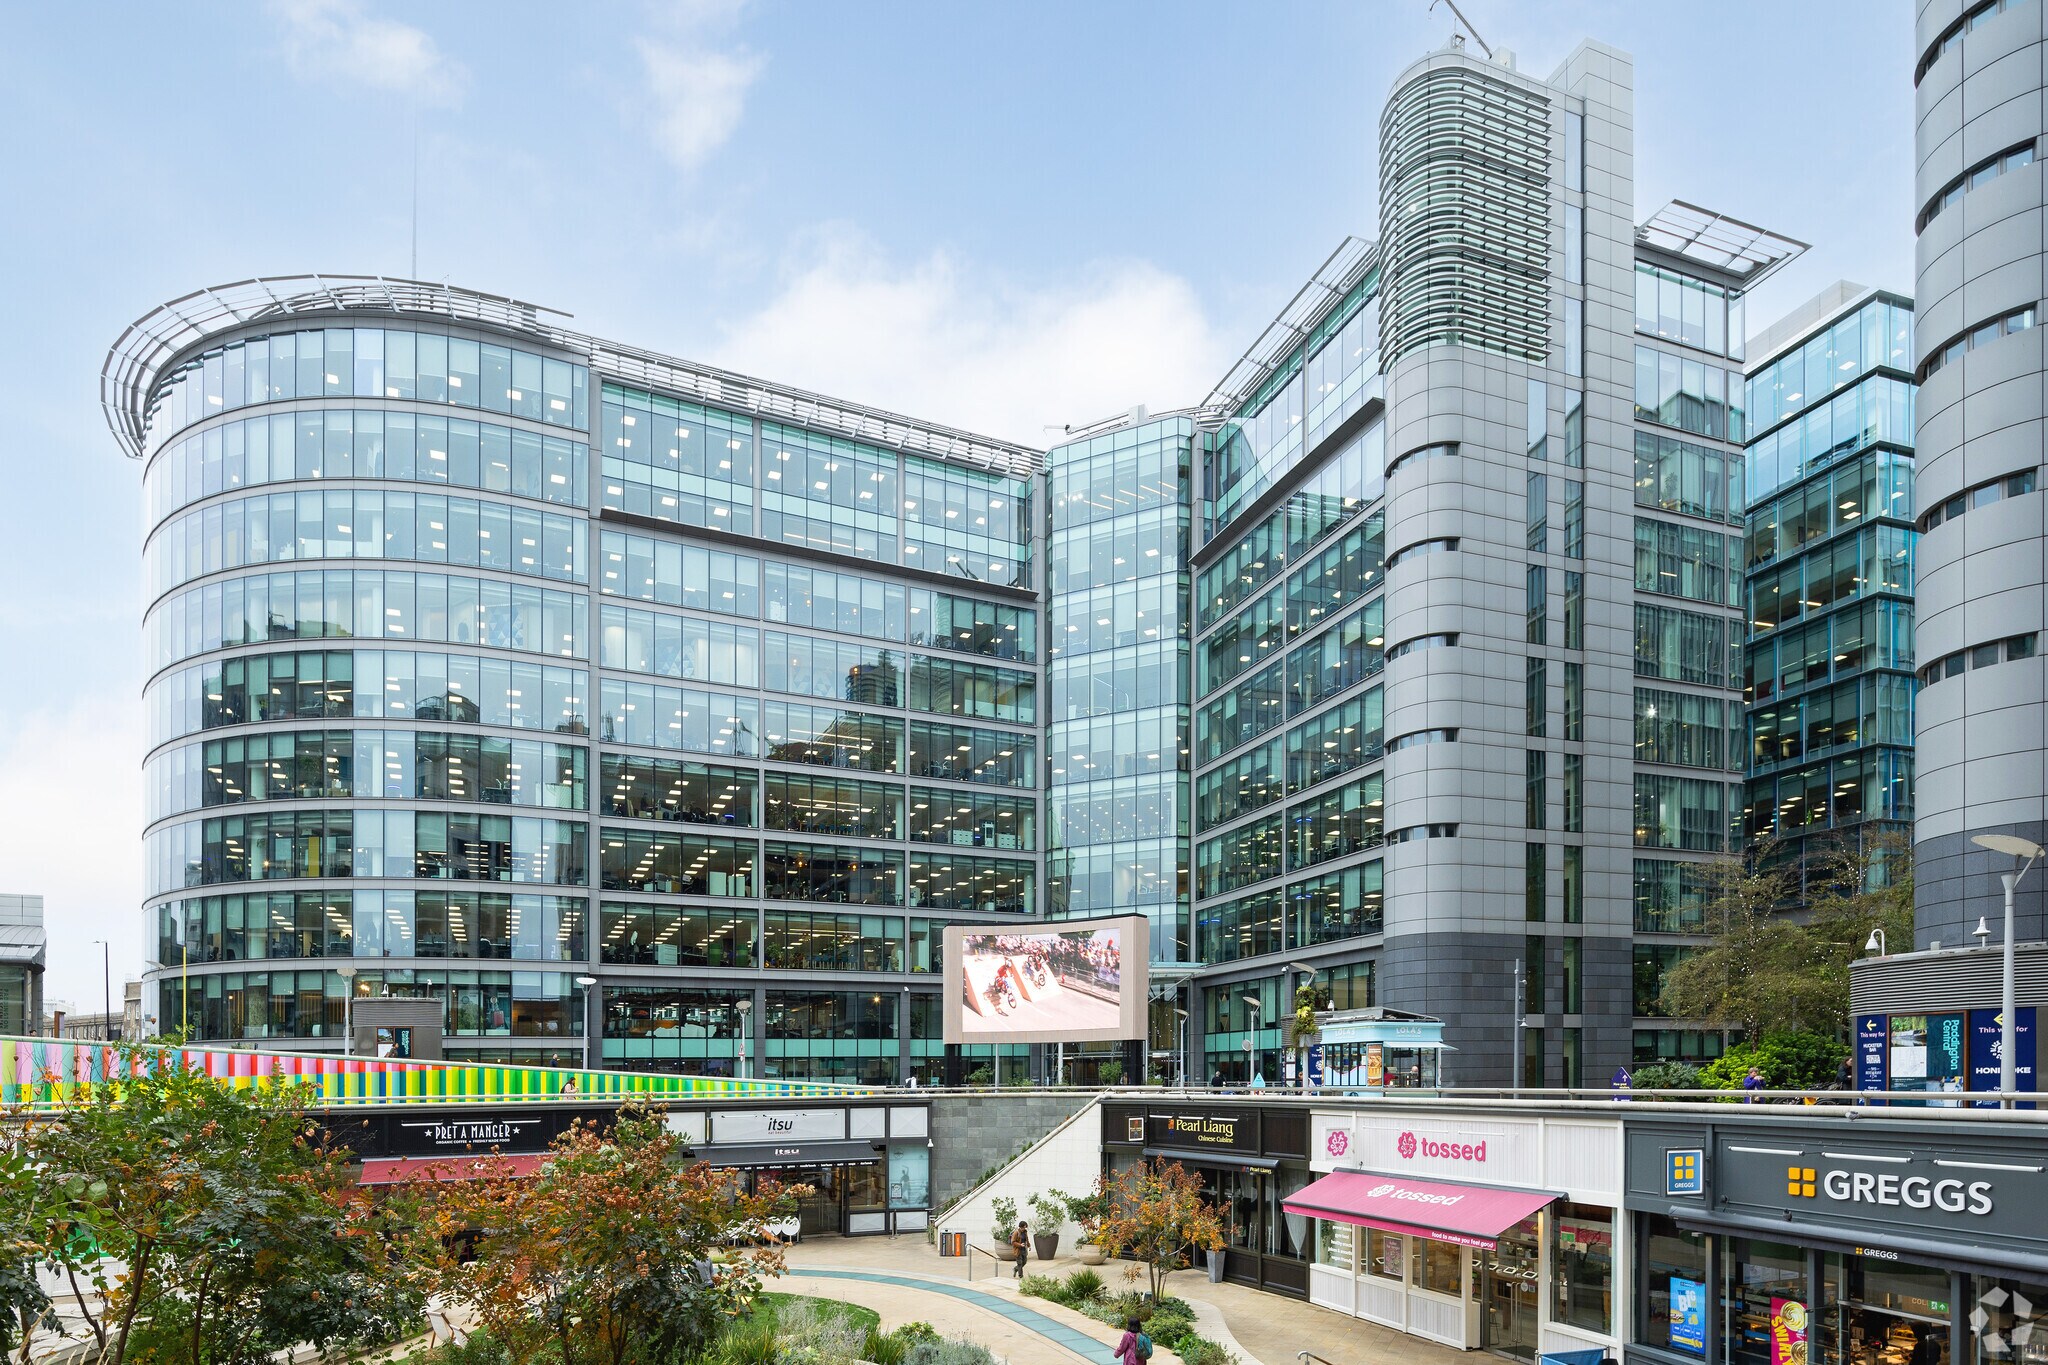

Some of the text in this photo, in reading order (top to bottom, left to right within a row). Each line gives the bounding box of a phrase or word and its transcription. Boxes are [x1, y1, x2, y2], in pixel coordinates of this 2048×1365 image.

[1943, 1020, 1952, 1050] Central
[1948, 1020, 1960, 1070] Paddington
[436, 1124, 510, 1139] PRET A MANGER
[768, 1118, 793, 1130] itsu
[1176, 1120, 1233, 1136] Pearl Liang
[1421, 1138, 1486, 1162] tossed
[1390, 1188, 1465, 1206] tossed
[1824, 1170, 1993, 1215] GREGGS
[1864, 1247, 1898, 1260] GREGGS
